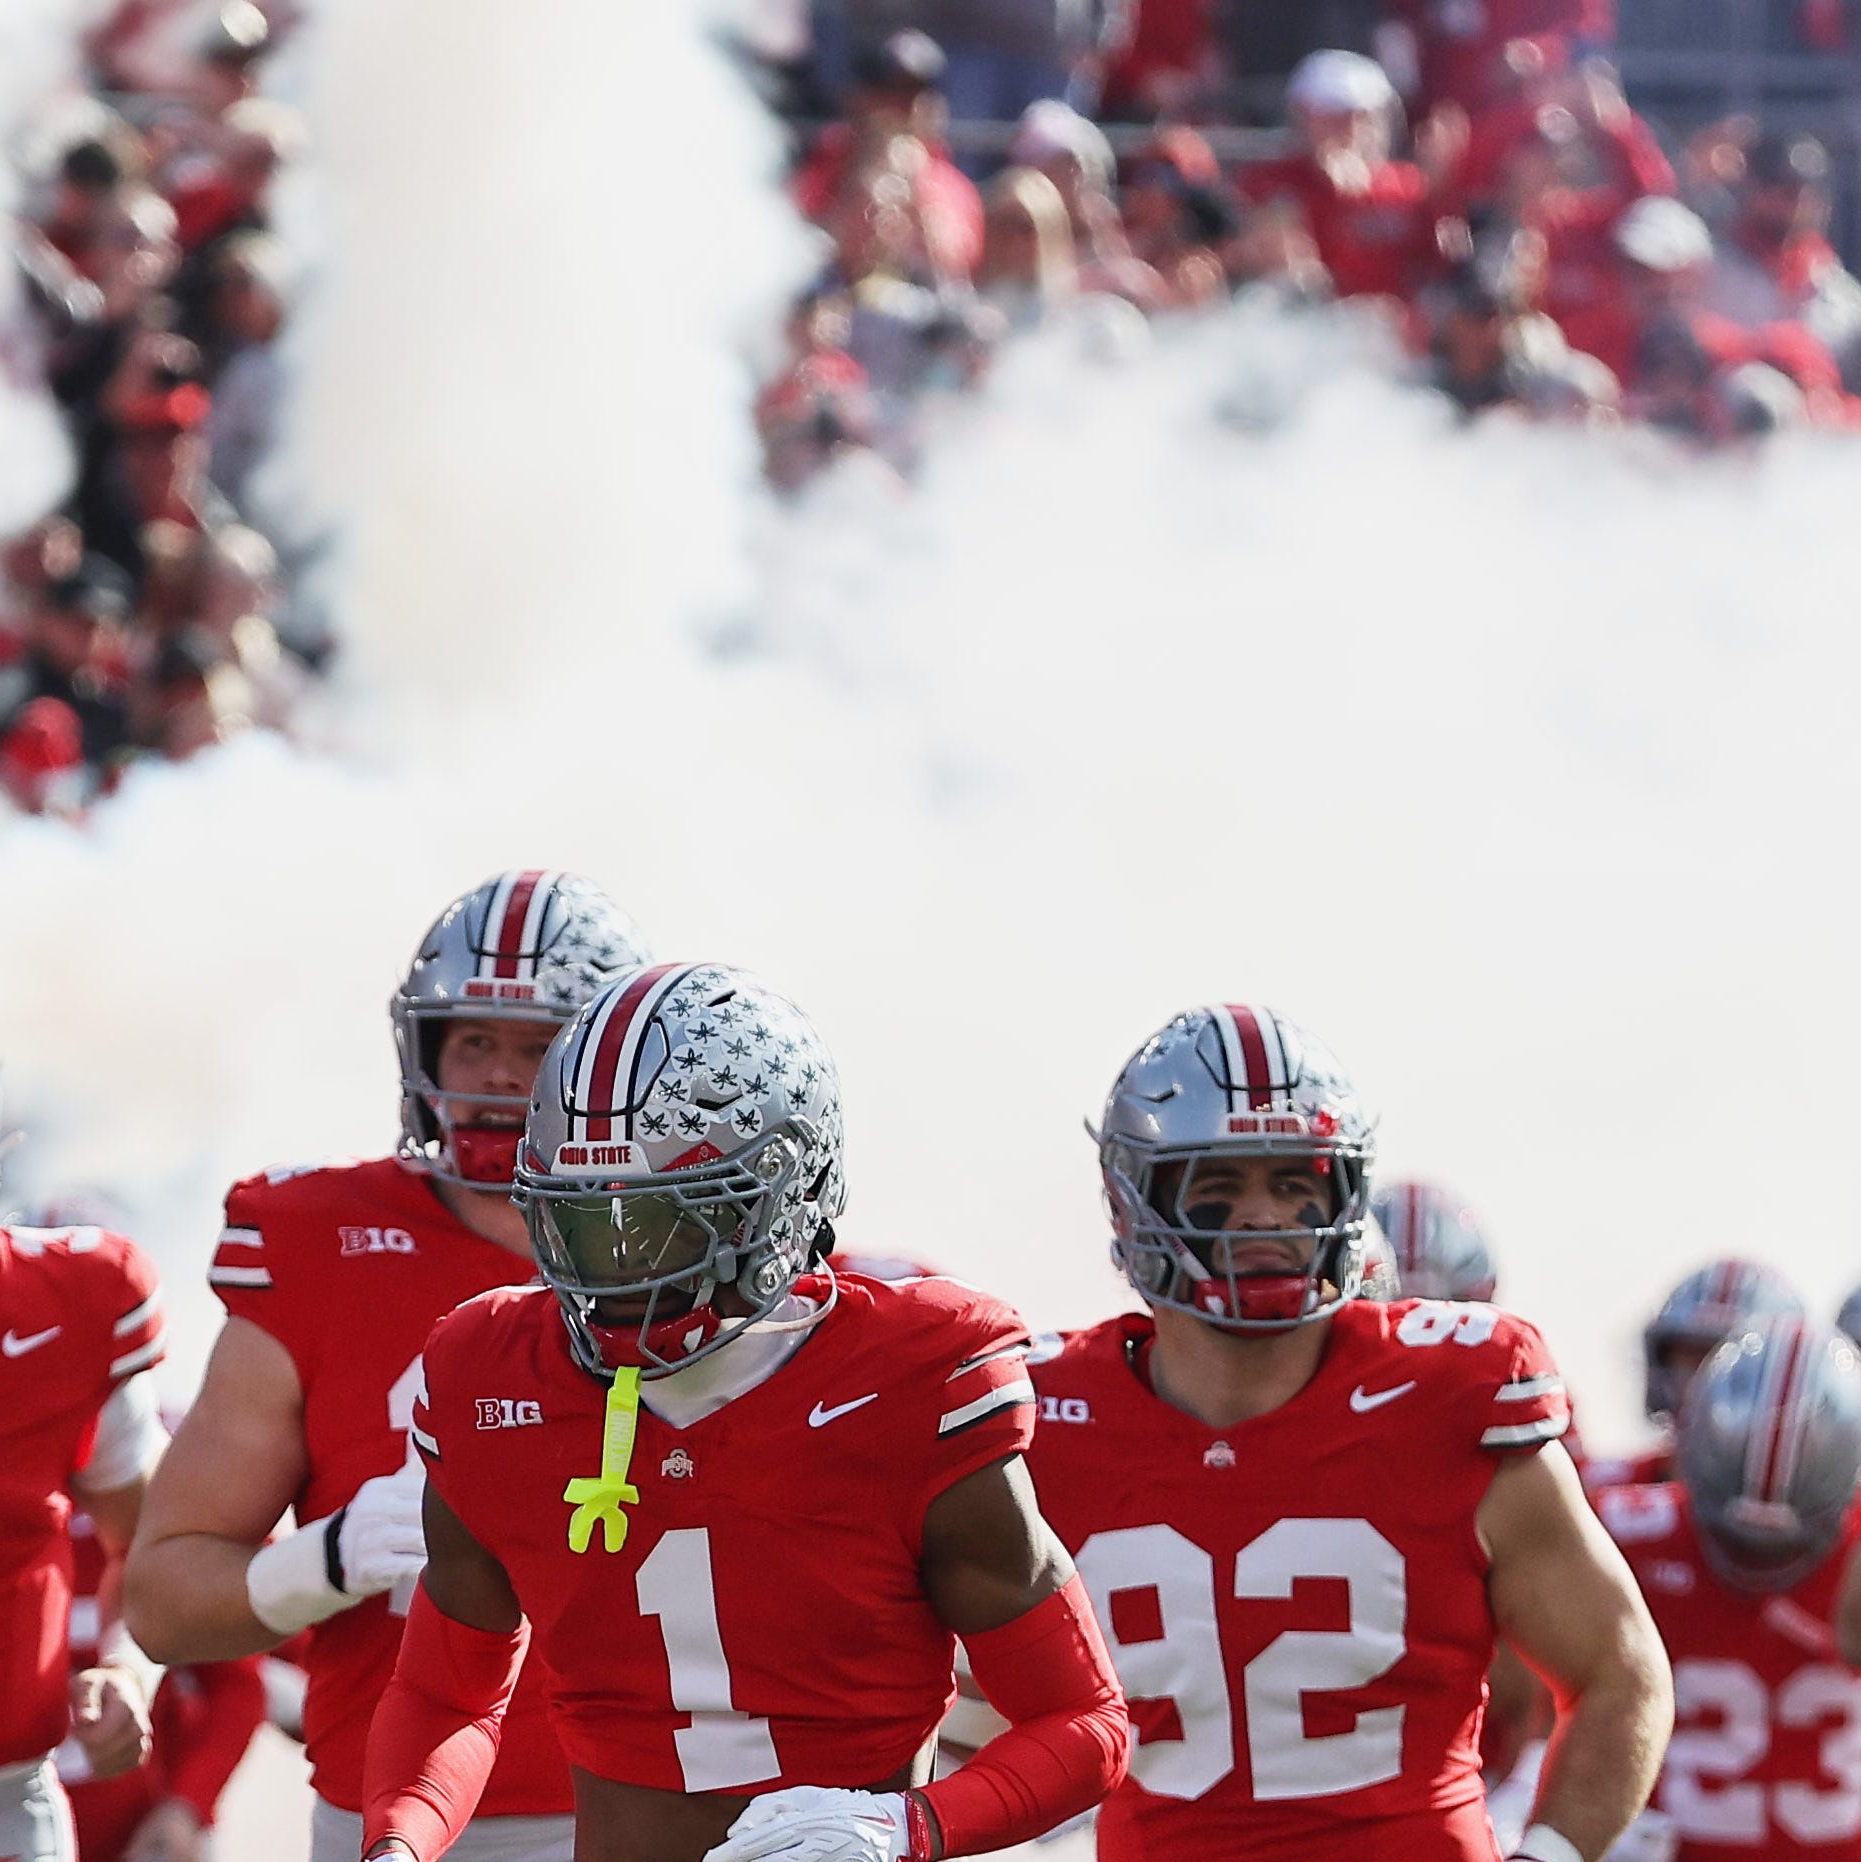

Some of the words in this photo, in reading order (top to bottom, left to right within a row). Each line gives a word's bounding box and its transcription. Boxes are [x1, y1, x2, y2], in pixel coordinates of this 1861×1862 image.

[559, 1146, 588, 1165] OHIO
[591, 1145, 632, 1165] STATE
[635, 1527, 783, 1793] 1
[1073, 1517, 1408, 1801] 92
